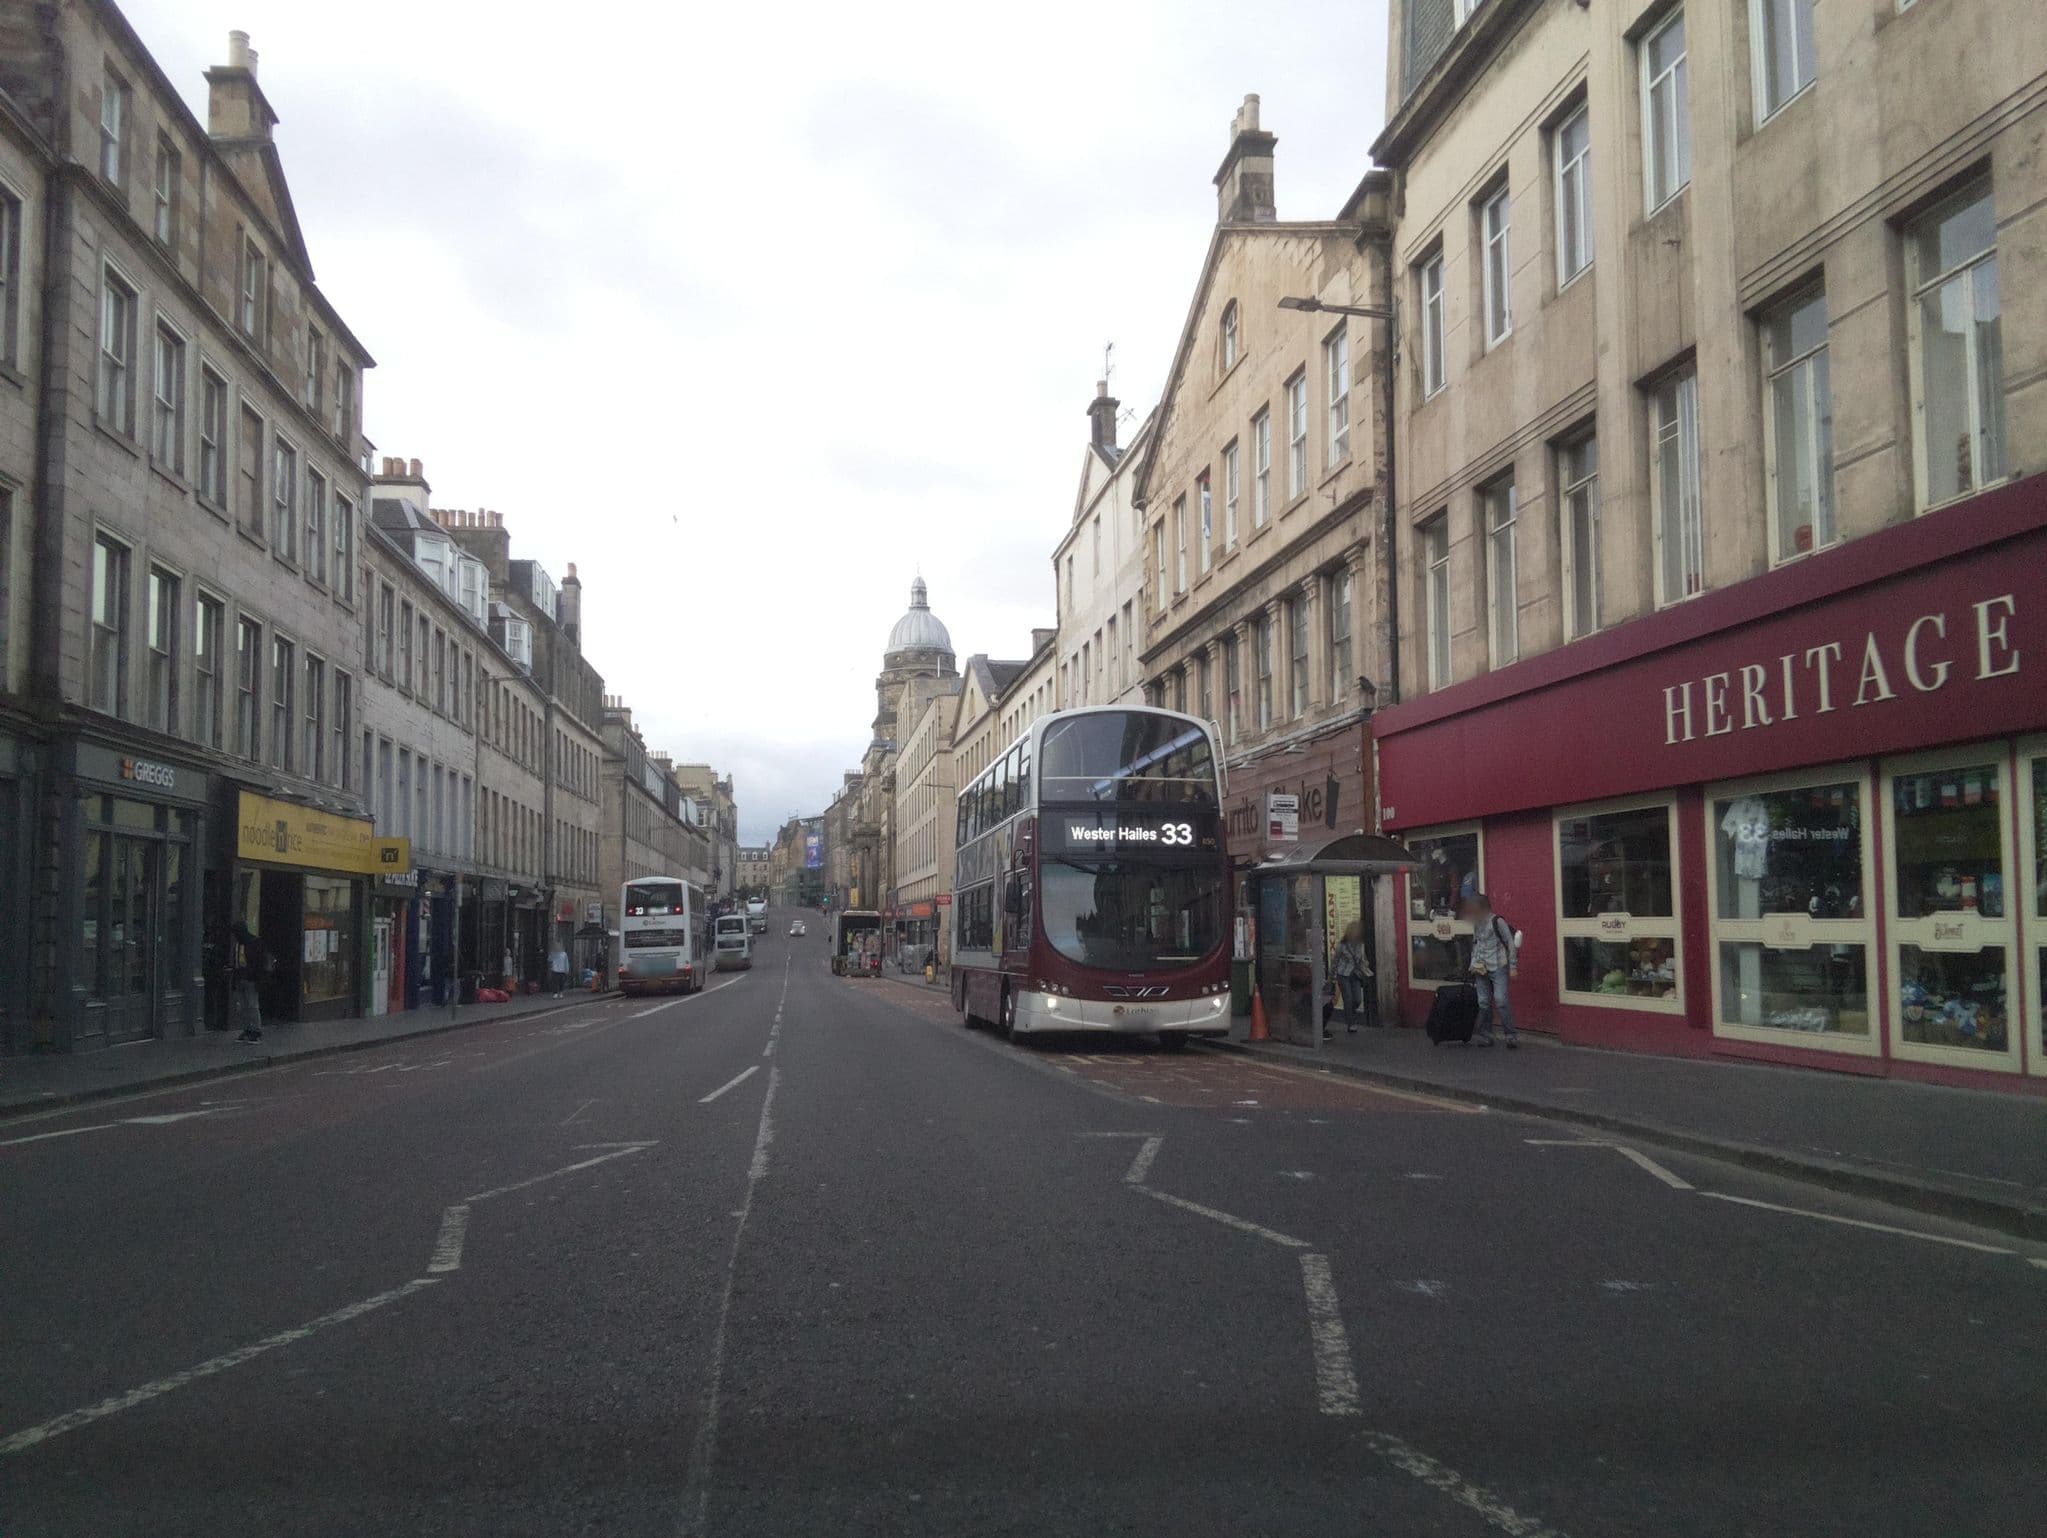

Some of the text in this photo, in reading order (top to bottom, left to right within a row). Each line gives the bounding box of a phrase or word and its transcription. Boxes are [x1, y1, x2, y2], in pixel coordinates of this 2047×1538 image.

[1662, 594, 2021, 745] HERITAGE
[135, 760, 175, 788] GREGGS
[1224, 796, 1259, 836] urrito
[1071, 823, 1193, 845] Wester Hailes 33
